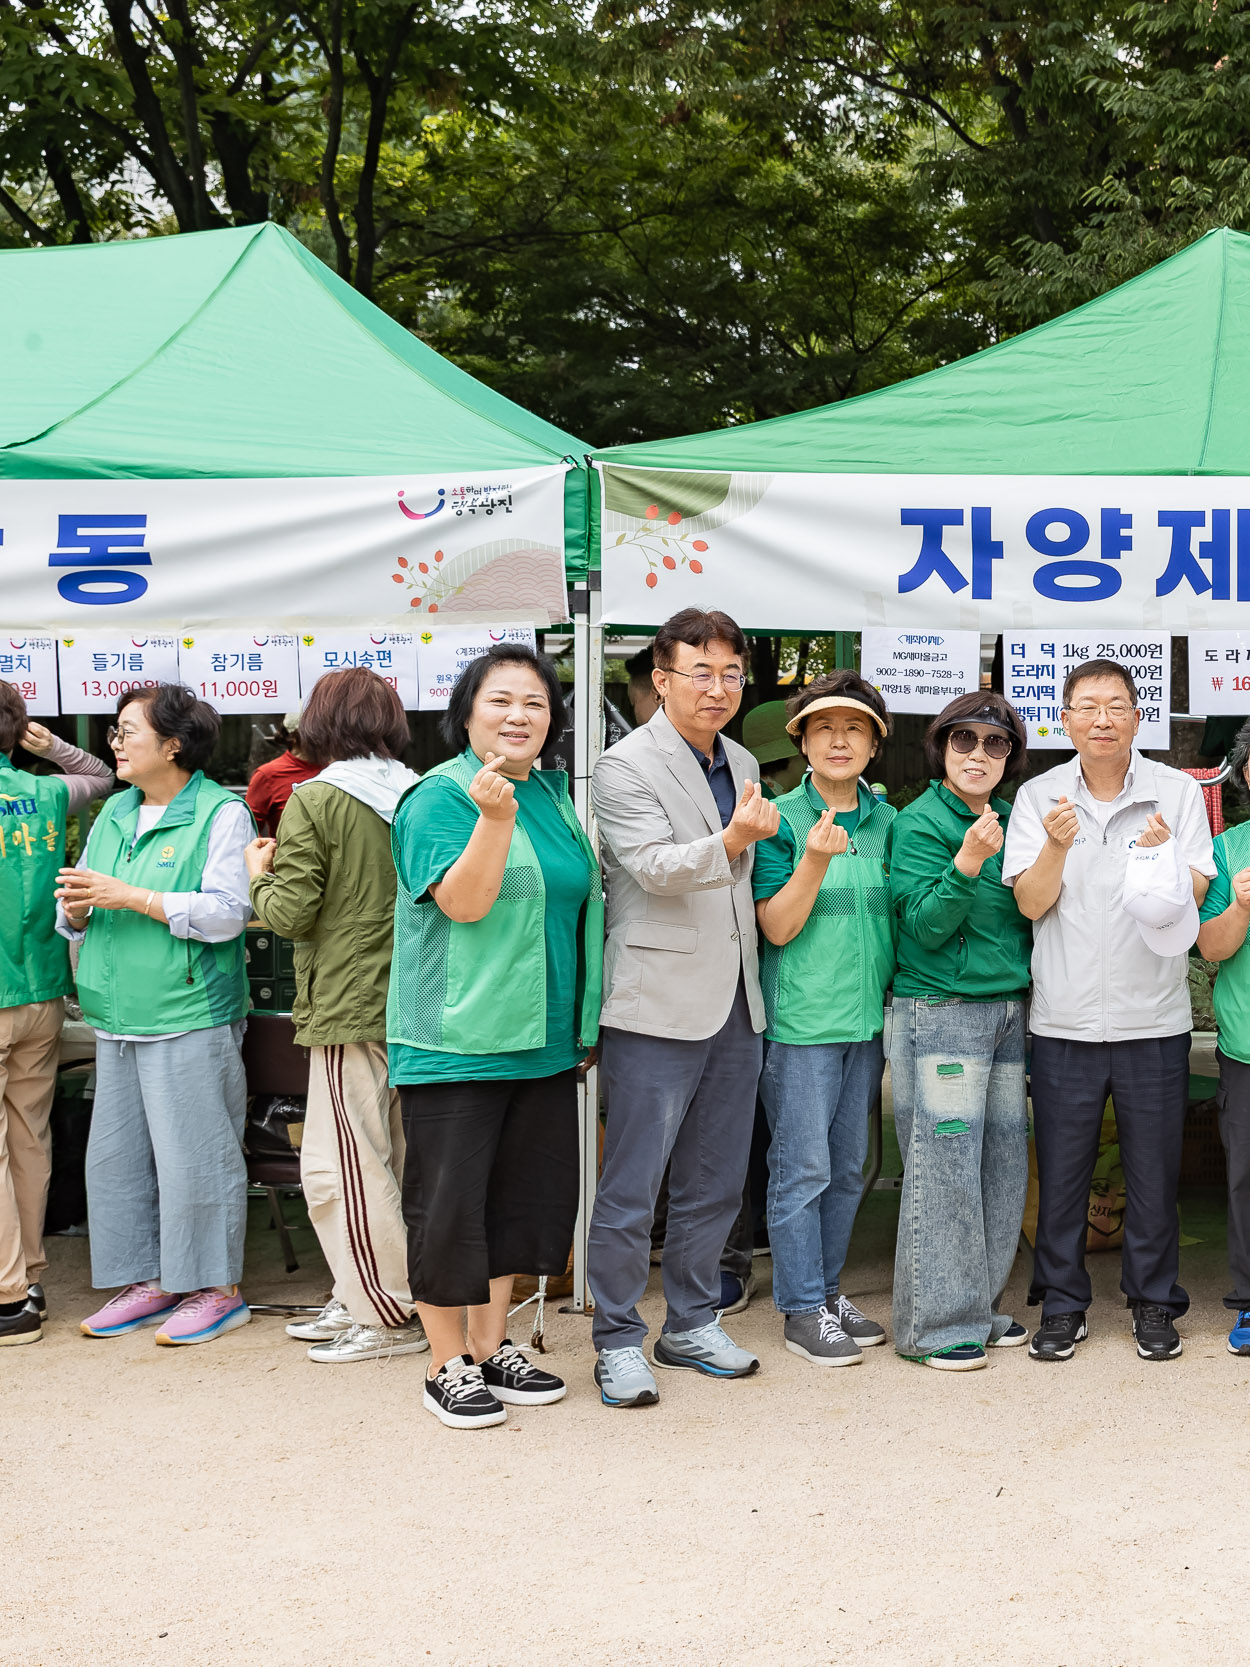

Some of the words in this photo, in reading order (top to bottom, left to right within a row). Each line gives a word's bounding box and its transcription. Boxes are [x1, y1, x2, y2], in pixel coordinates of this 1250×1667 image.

[897, 634, 945, 646] <계좌이체>
[322, 649, 393, 669] 모시송편
[456, 646, 491, 658] <계좌이
[892, 651, 948, 662] MG새마을금고
[1011, 643, 1026, 659] 더
[1040, 643, 1055, 659] 덕
[1062, 643, 1090, 660] 1kg
[1096, 643, 1163, 660] 25,000원
[0, 654, 31, 673] 멸치
[92, 653, 144, 672] 들기름
[210, 653, 264, 672] 참기름
[875, 667, 965, 680] 9002-1890-7528-3
[1011, 664, 1055, 680] 도라지
[1122, 664, 1163, 681] 00원
[199, 679, 279, 700] 11,000원
[881, 683, 912, 695] 자양1동
[1011, 685, 1055, 701] 모시떡
[1137, 685, 1163, 702] 0원
